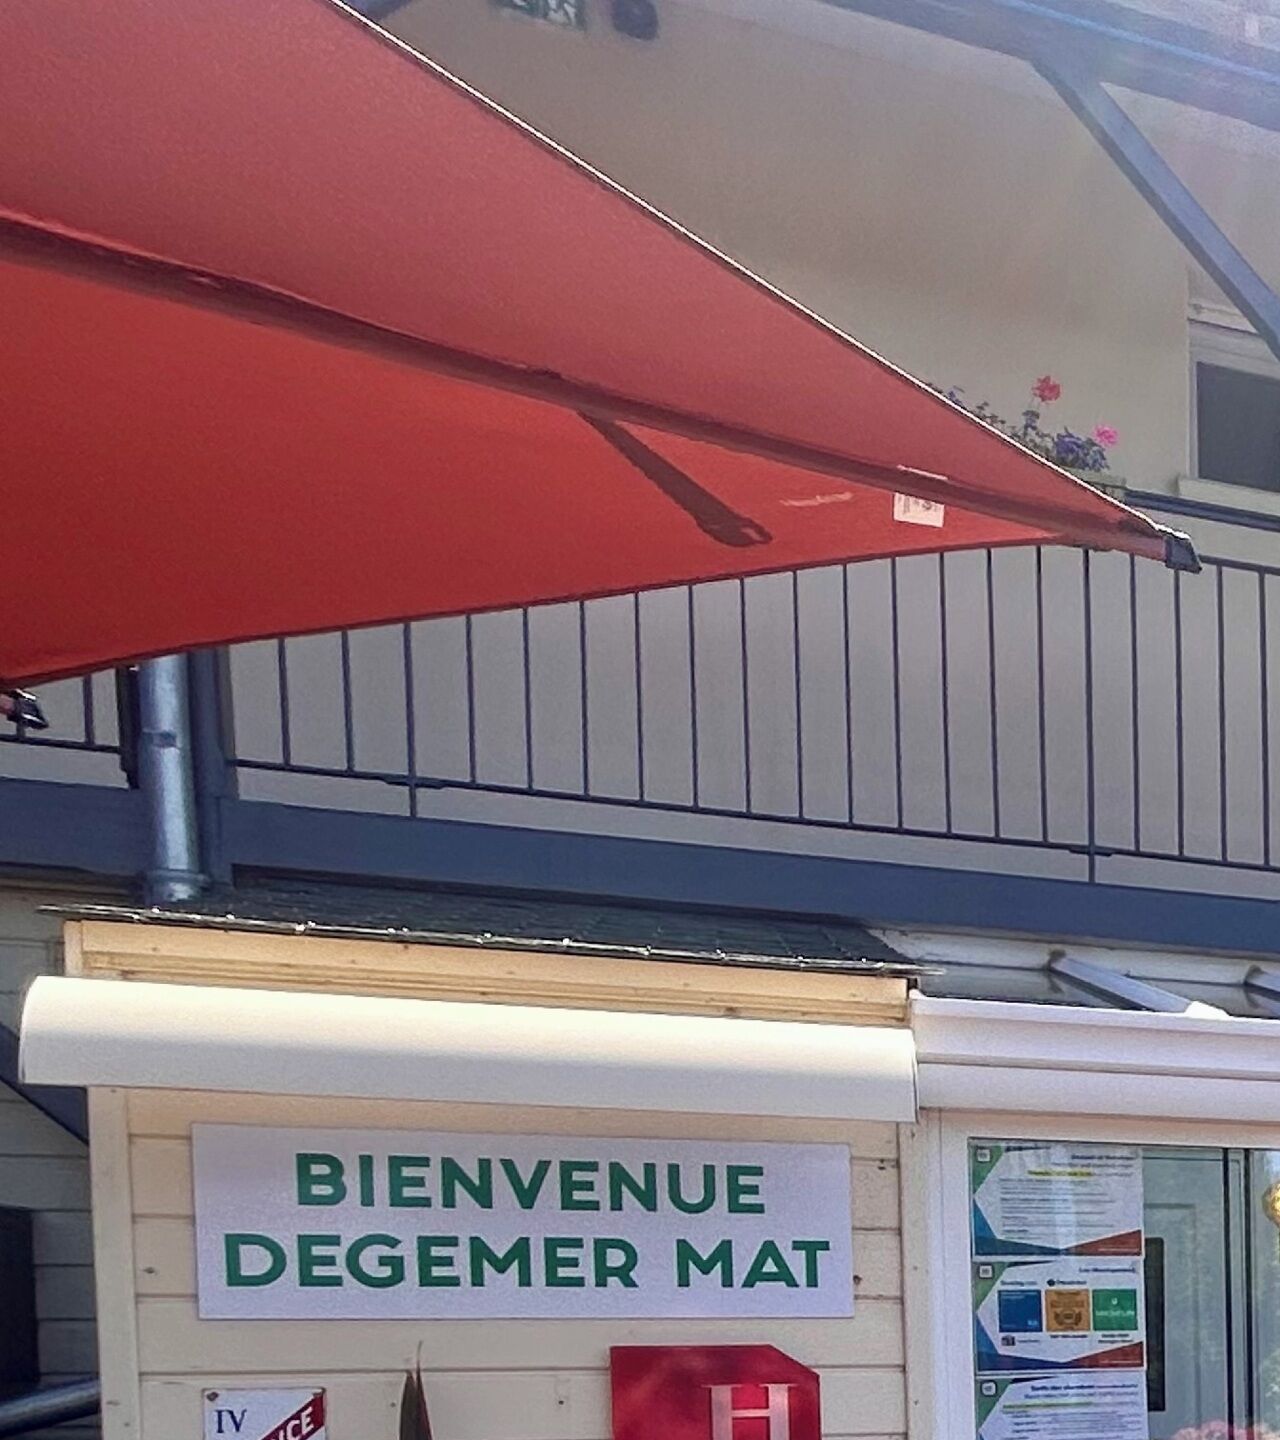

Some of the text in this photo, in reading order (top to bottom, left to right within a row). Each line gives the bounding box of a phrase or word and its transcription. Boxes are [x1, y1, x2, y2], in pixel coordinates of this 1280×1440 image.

[295, 1152, 766, 1215] BIENVENUE
[224, 1232, 831, 1290] DEGEMER MAT
[215, 1408, 248, 1434] IV
